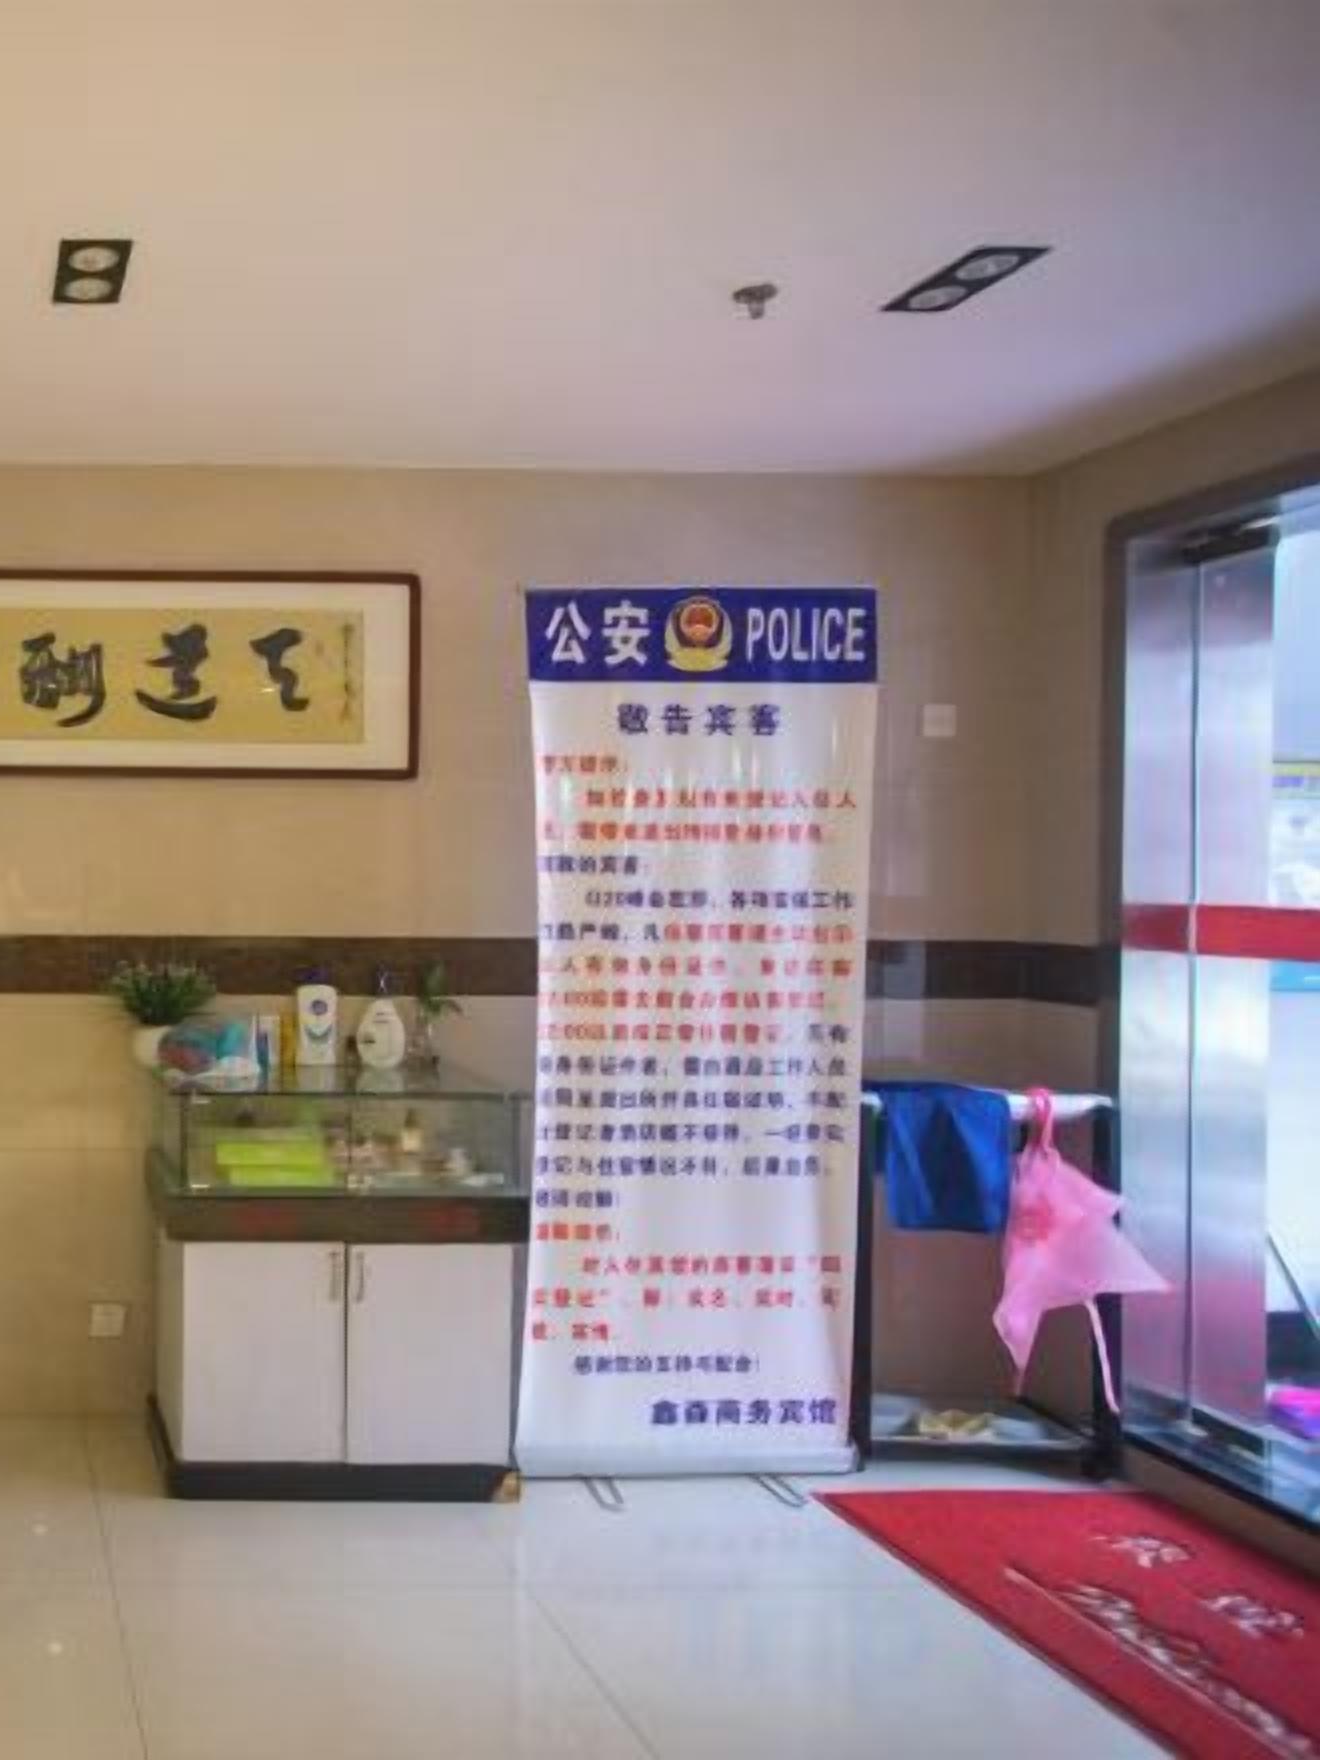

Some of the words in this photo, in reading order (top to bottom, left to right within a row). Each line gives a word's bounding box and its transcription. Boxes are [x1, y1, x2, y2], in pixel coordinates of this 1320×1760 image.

[544, 600, 652, 665] 公安
[746, 607, 867, 662] POLICE
[617, 703, 780, 736] 敬告宾客
